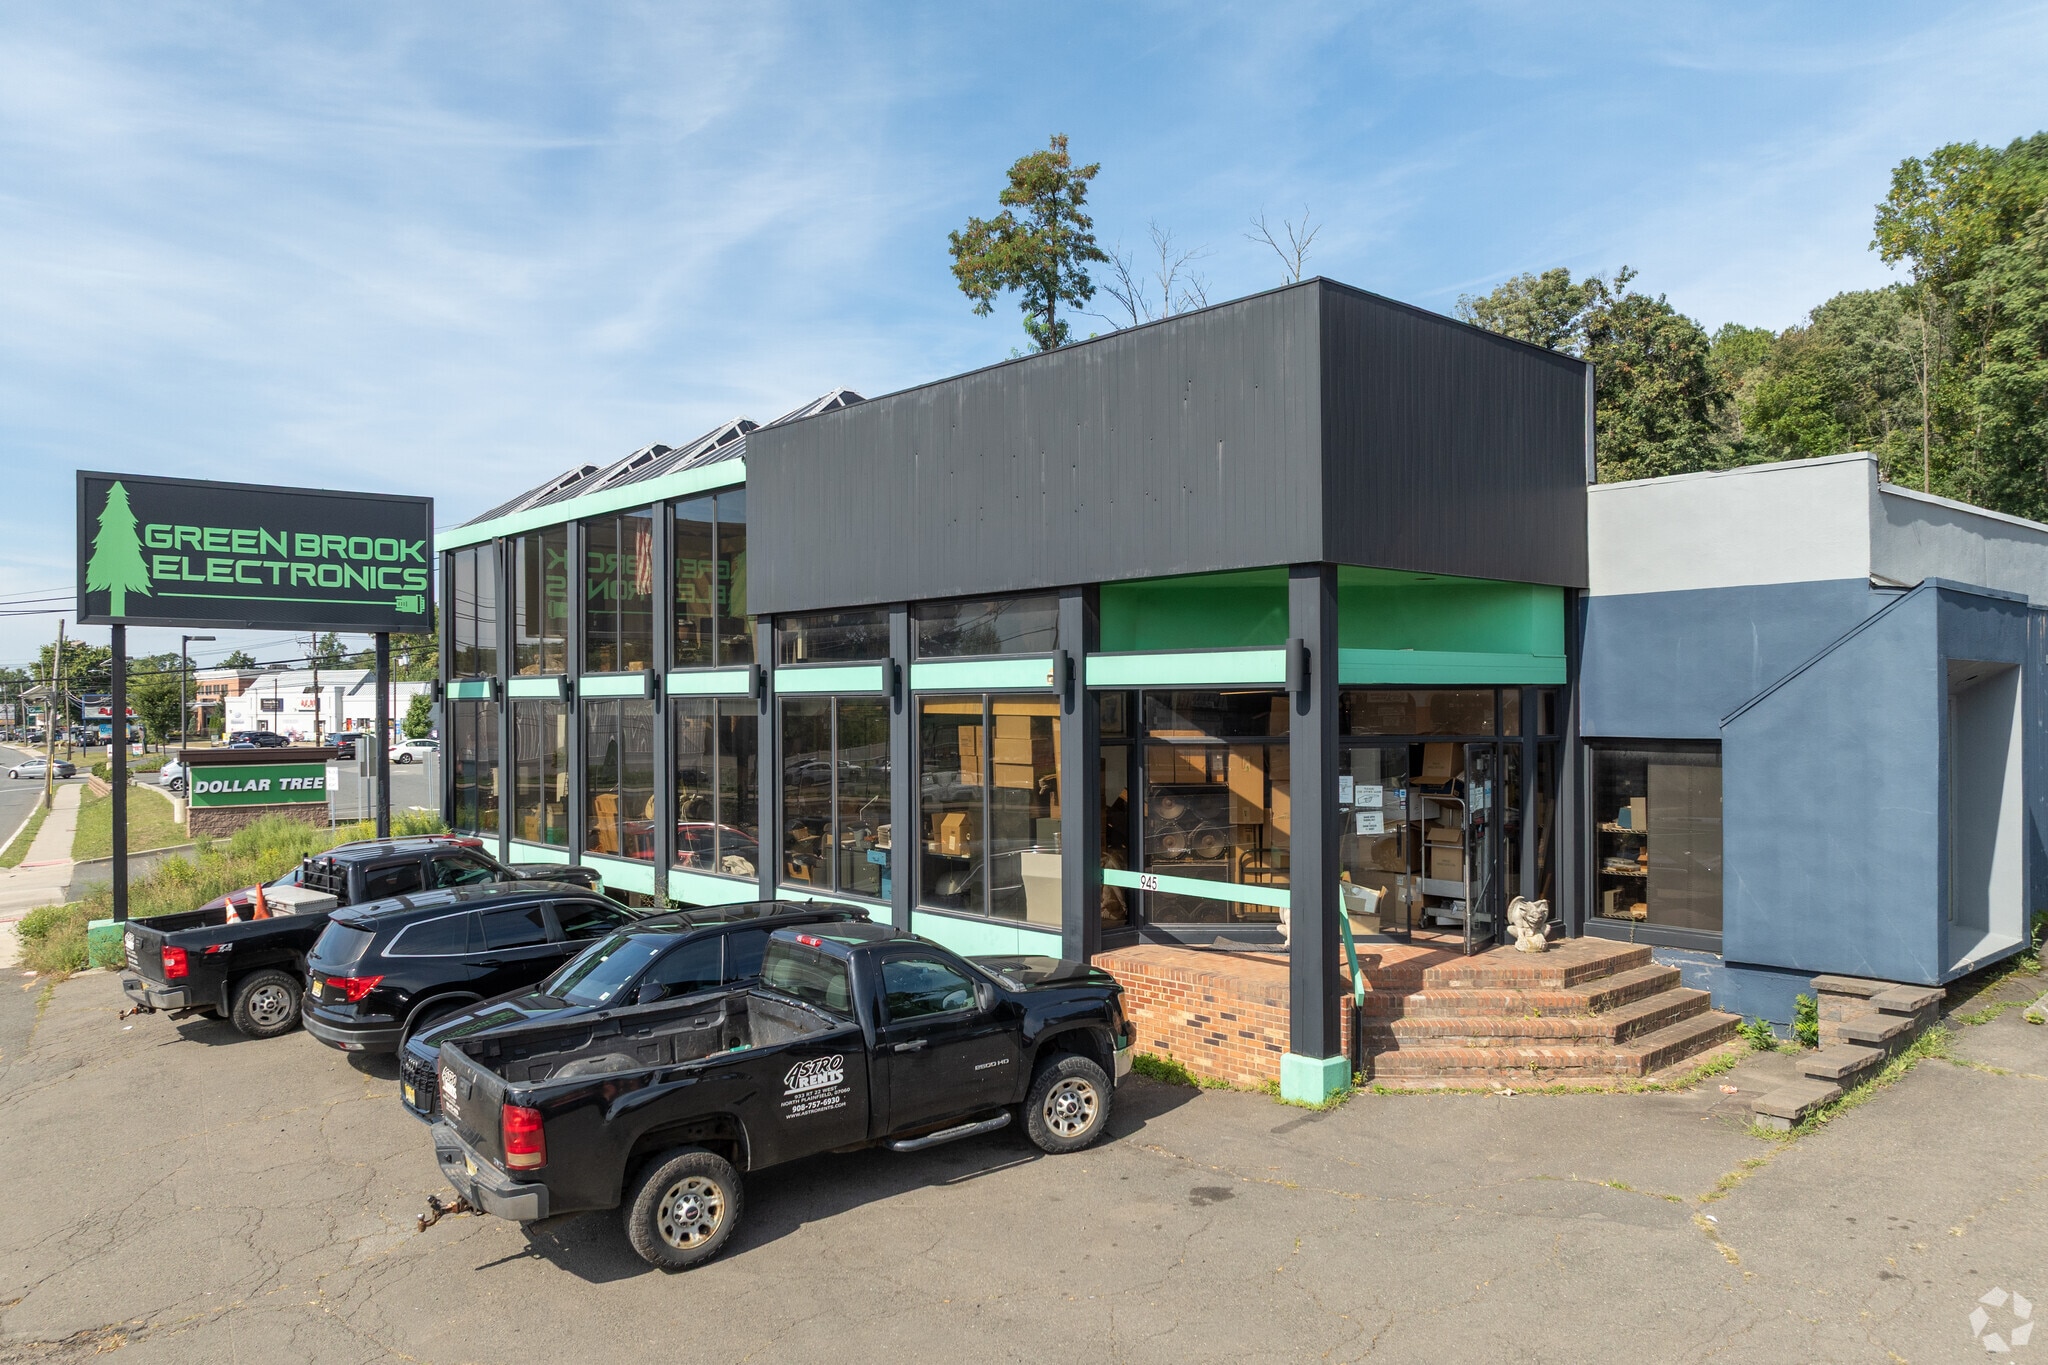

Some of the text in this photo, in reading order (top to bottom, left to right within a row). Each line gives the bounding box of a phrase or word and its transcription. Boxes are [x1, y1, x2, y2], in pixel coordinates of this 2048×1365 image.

[144, 524, 426, 562] GREEN BROOK
[152, 555, 427, 591] ELECTRONICS
[195, 779, 271, 793] DOLLAR
[279, 777, 324, 790] TREE
[1141, 875, 1157, 889] 945
[784, 1054, 843, 1089] ASTRO
[799, 1068, 843, 1088] RENTS
[781, 1087, 850, 1107] NORTH PLAINFIELD, 07060
[792, 1096, 840, 1113] 908-757-6930
[786, 1102, 846, 1119] WWW.ASTRORENTS.COM
